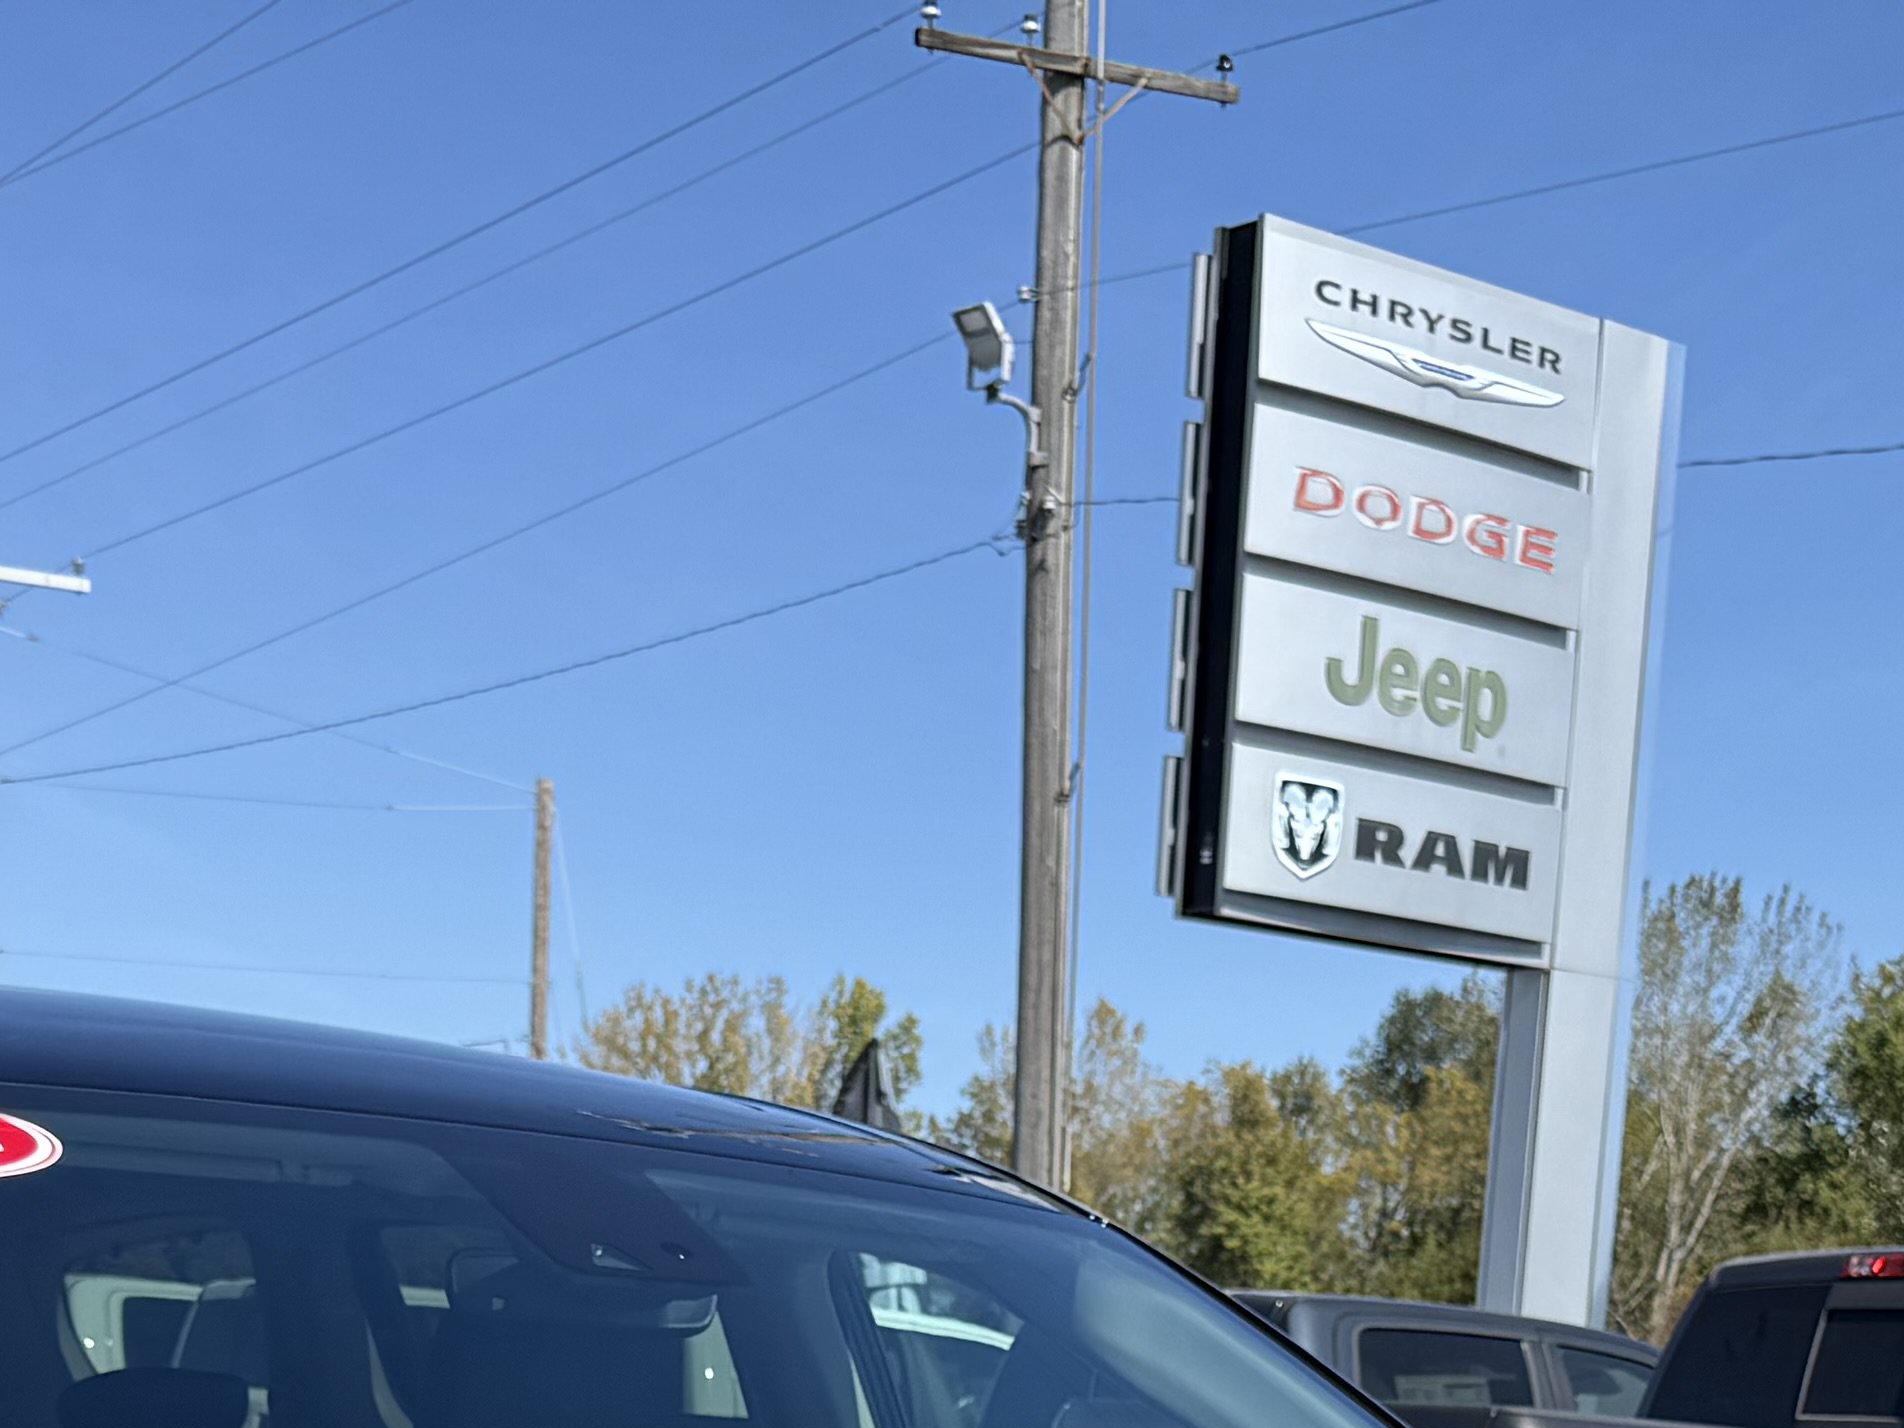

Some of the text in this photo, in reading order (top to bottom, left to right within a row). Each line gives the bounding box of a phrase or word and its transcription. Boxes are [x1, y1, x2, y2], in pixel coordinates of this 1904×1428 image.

[1314, 279, 1563, 376] CHRYSLER
[1294, 466, 1558, 573] DODGE
[1325, 615, 1507, 752] Jeep
[1354, 817, 1531, 891] RAM
